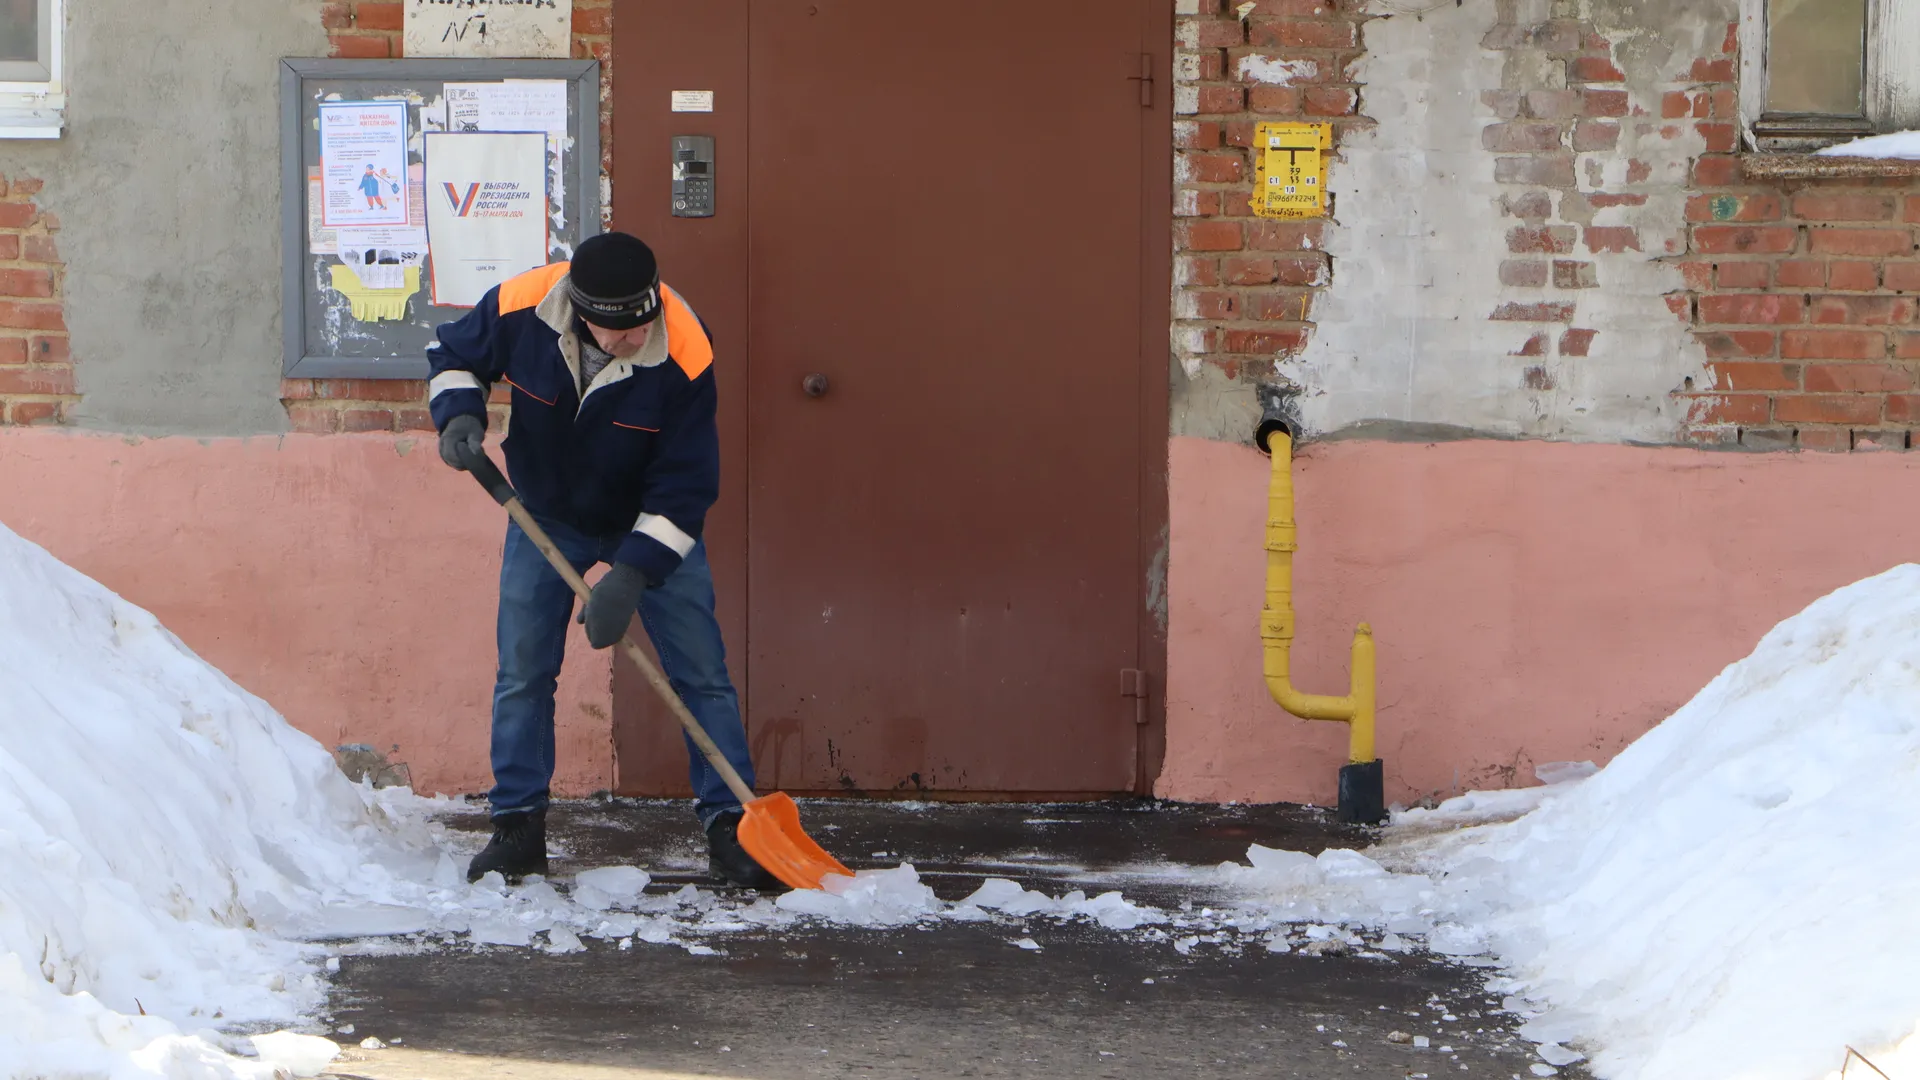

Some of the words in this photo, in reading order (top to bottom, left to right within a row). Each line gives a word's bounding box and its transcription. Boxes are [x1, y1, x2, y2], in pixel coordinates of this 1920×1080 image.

[483, 182, 520, 190] ВЫБОРЫ
[479, 192, 530, 200] ПРЕЗИДЕНТА
[475, 201, 508, 209] РОССИИ
[592, 303, 624, 311] adidas
